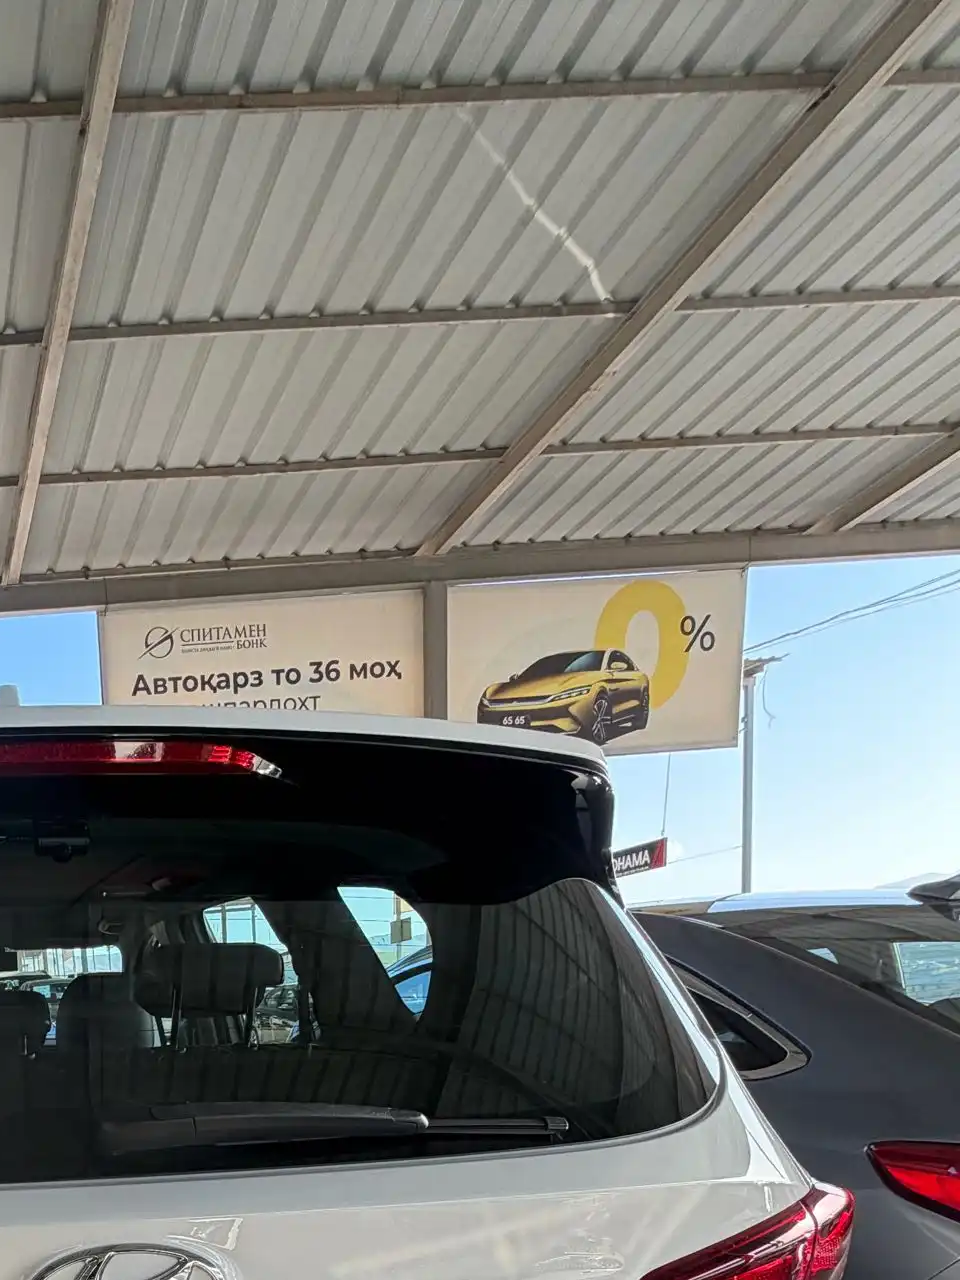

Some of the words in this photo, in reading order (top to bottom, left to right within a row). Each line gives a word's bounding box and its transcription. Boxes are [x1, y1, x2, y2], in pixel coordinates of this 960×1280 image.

[180, 623, 267, 642] СПИТАМЕН
[236, 638, 268, 650] БОНК
[131, 669, 264, 697] Автоқарз
[270, 667, 302, 686] то
[308, 659, 341, 683] 36
[514, 715, 525, 725] 65
